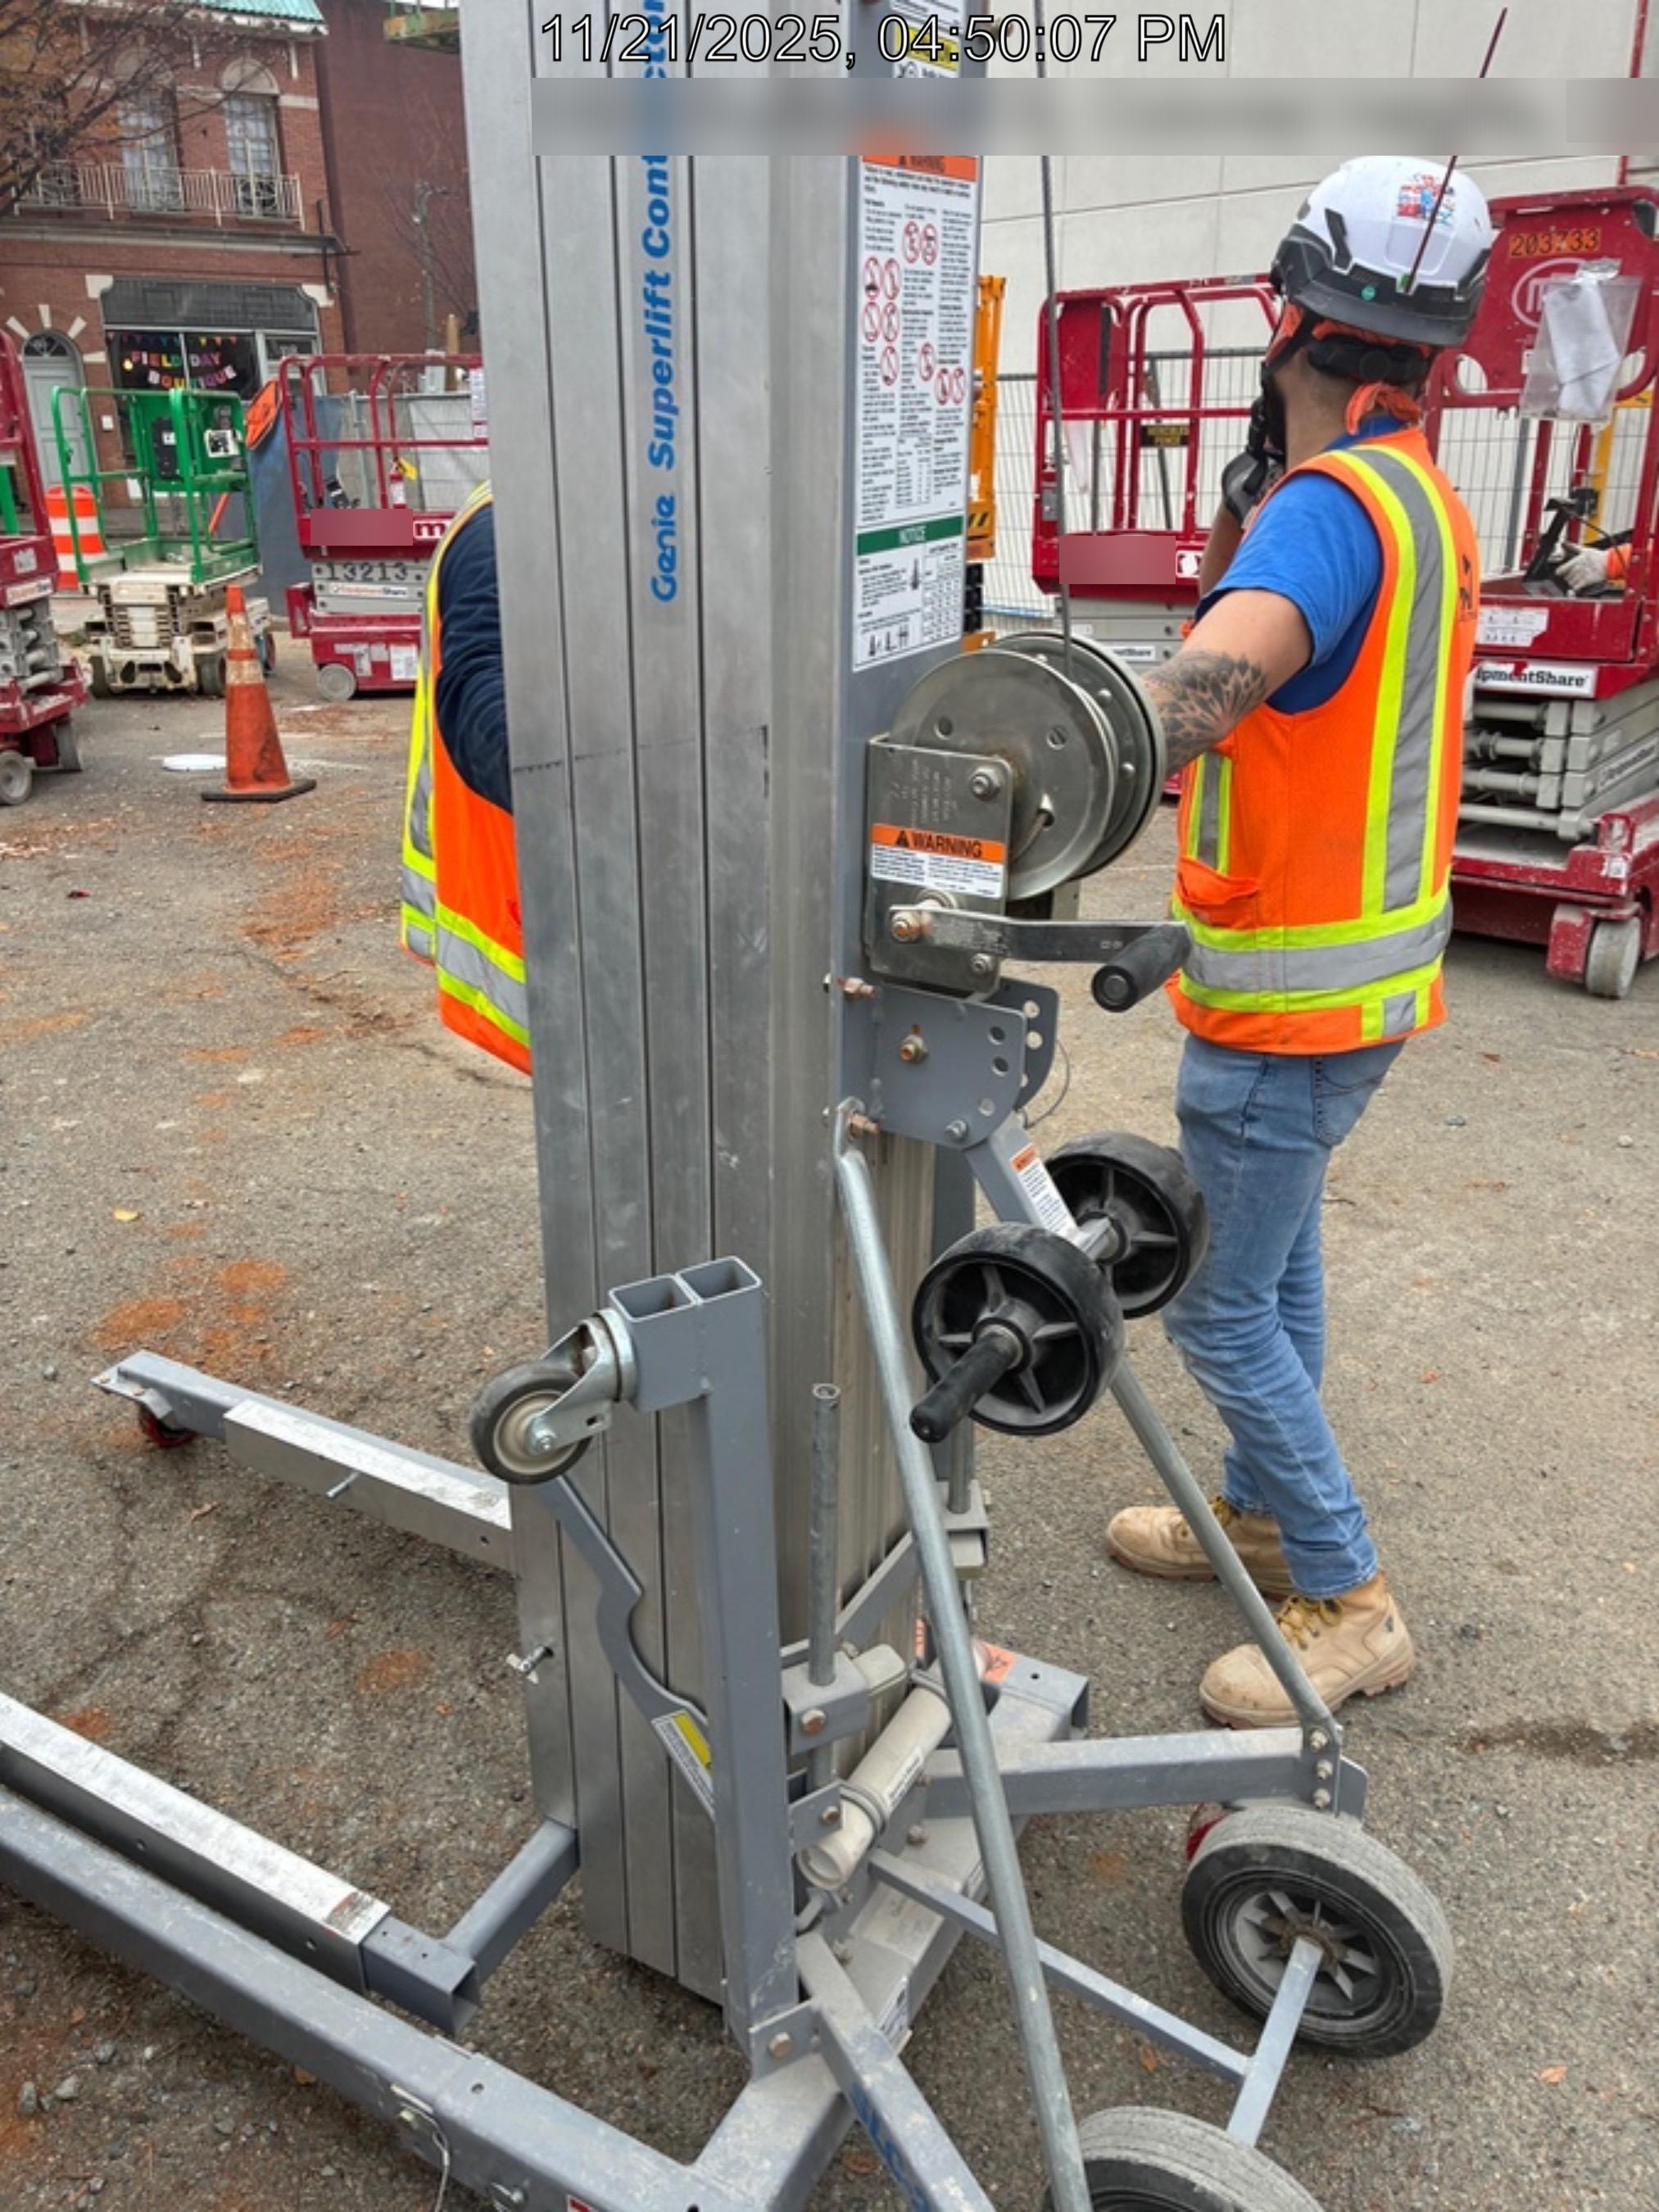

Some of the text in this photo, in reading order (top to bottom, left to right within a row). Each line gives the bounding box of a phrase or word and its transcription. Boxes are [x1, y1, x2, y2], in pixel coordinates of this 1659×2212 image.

[132, 351, 221, 367] FIELD DAY
[644, 270, 680, 470] Superlift
[650, 494, 678, 602] Genie
[327, 562, 407, 581] 13213
[912, 830, 982, 859] WARNING
